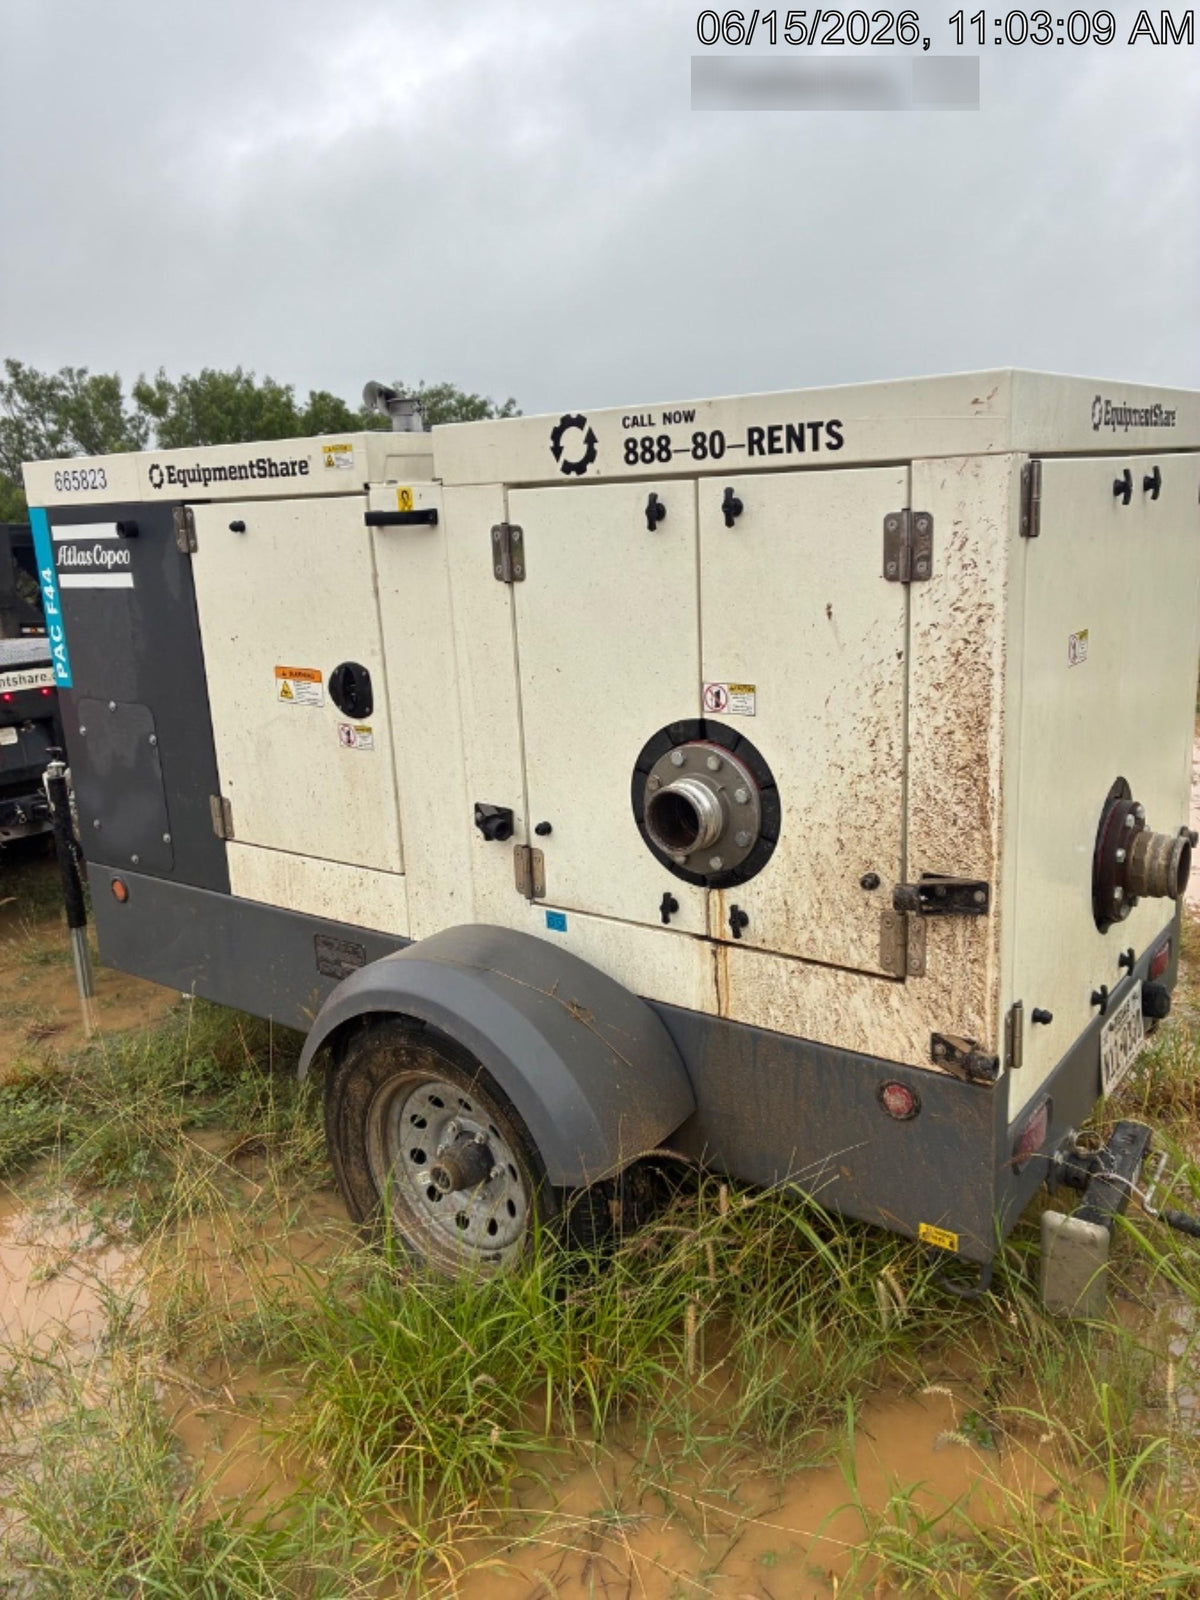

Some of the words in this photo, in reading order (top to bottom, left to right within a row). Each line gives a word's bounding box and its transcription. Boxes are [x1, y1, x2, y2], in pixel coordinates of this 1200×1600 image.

[622, 413, 656, 429] CALL
[662, 409, 696, 426] NOW
[1103, 399, 1176, 433] EquipmentShare
[623, 419, 844, 466] 888-80-RENTS
[54, 468, 107, 491] 665823
[166, 458, 309, 487] EquipmentShare
[42, 567, 59, 614] F44
[50, 625, 68, 678] PAC
